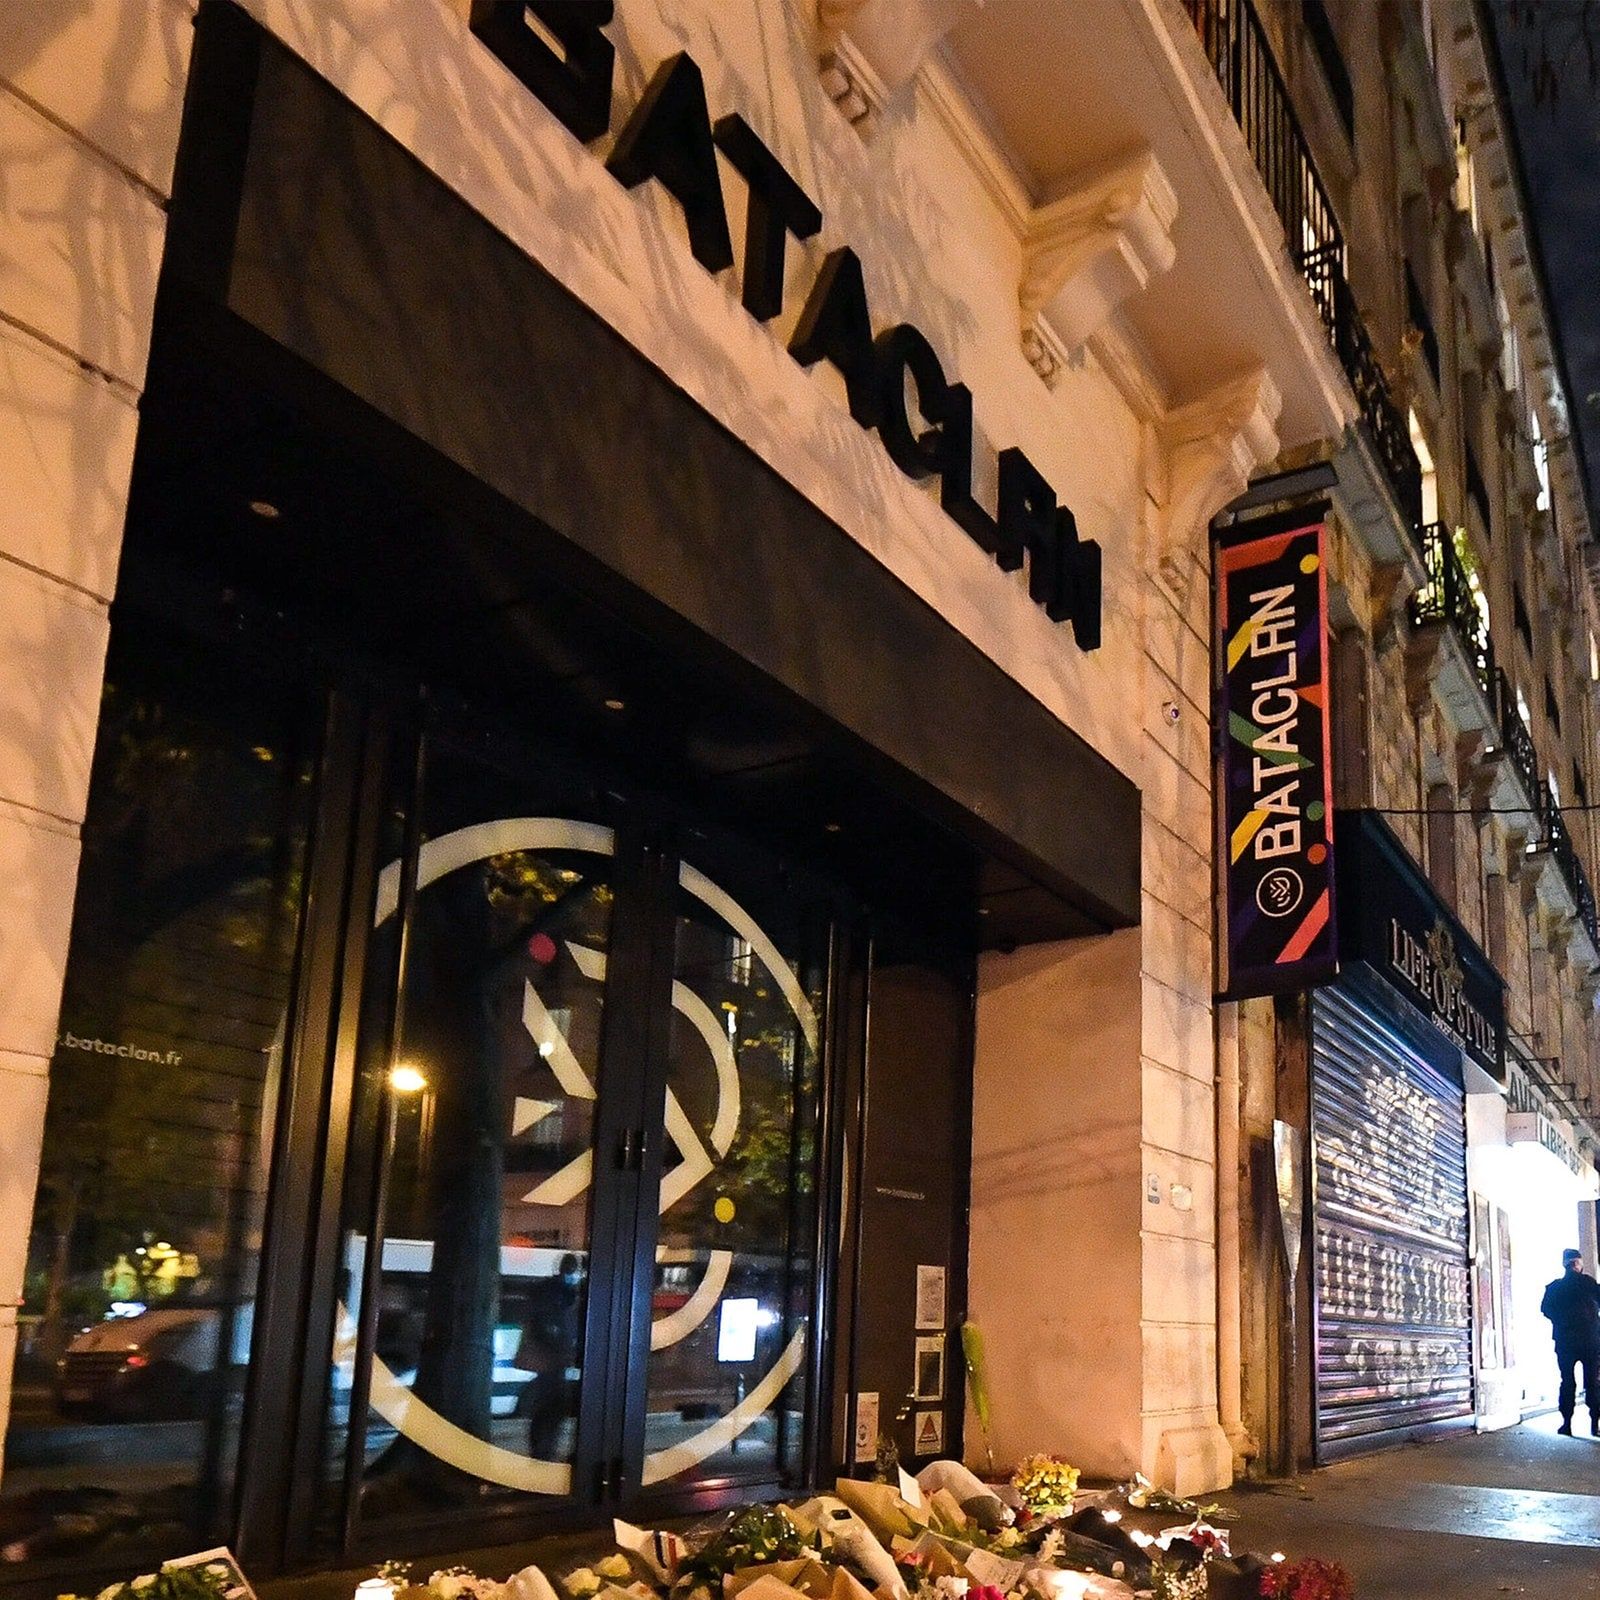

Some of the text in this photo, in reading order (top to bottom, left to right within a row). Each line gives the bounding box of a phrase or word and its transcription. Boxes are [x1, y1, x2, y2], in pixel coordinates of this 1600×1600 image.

[1249, 583, 1302, 861] BATACLAN
[1391, 918, 1497, 1065] LIFE OF STYLE
